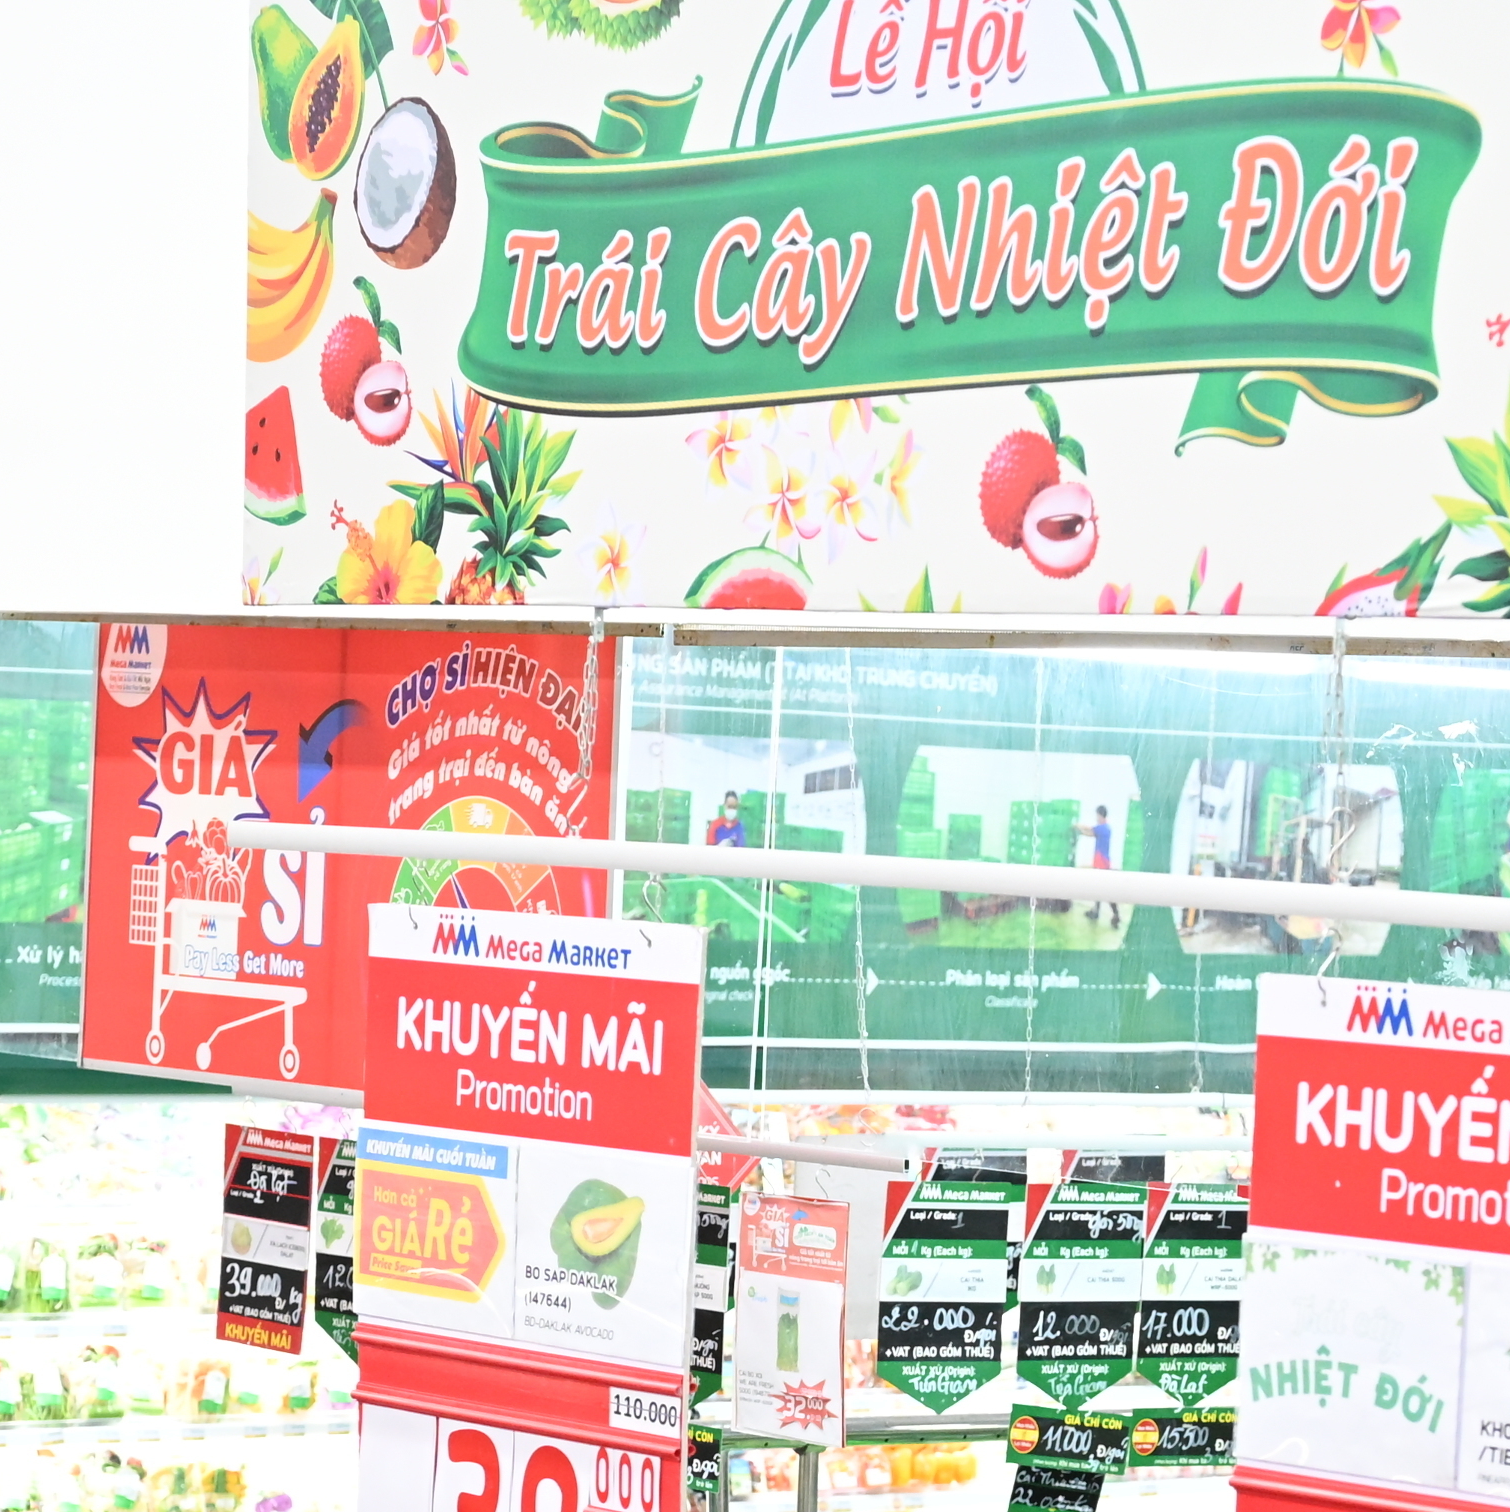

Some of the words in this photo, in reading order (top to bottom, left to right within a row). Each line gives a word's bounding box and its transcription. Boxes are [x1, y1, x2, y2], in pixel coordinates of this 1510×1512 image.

[503, 226, 669, 352] Trái
[696, 219, 866, 365] Cây
[899, 156, 1187, 332] Nhiệt
[1223, 137, 1417, 296] Đới
[386, 658, 441, 728] CHỢ
[443, 640, 471, 693] SỈ
[471, 644, 538, 698] HIỆN
[160, 714, 252, 797] GIÁ
[184, 944, 210, 976] Pay
[211, 948, 240, 973] Less
[243, 950, 266, 975] Get
[269, 953, 304, 978] More
[486, 935, 542, 963] Mega
[548, 939, 631, 970] Market
[397, 980, 567, 1066] KHUYẾN
[581, 1001, 663, 1076] MÃI
[456, 1068, 592, 1121] Promotion
[524, 1291, 571, 1312] (147644)
[525, 1266, 540, 1279] BO
[544, 1269, 566, 1283] SAP
[570, 1272, 616, 1292] DAKLAK
[613, 1394, 677, 1427] 110.000
[1250, 1344, 1358, 1408] NHIỆT
[1374, 1374, 1445, 1433] ĐỚI
